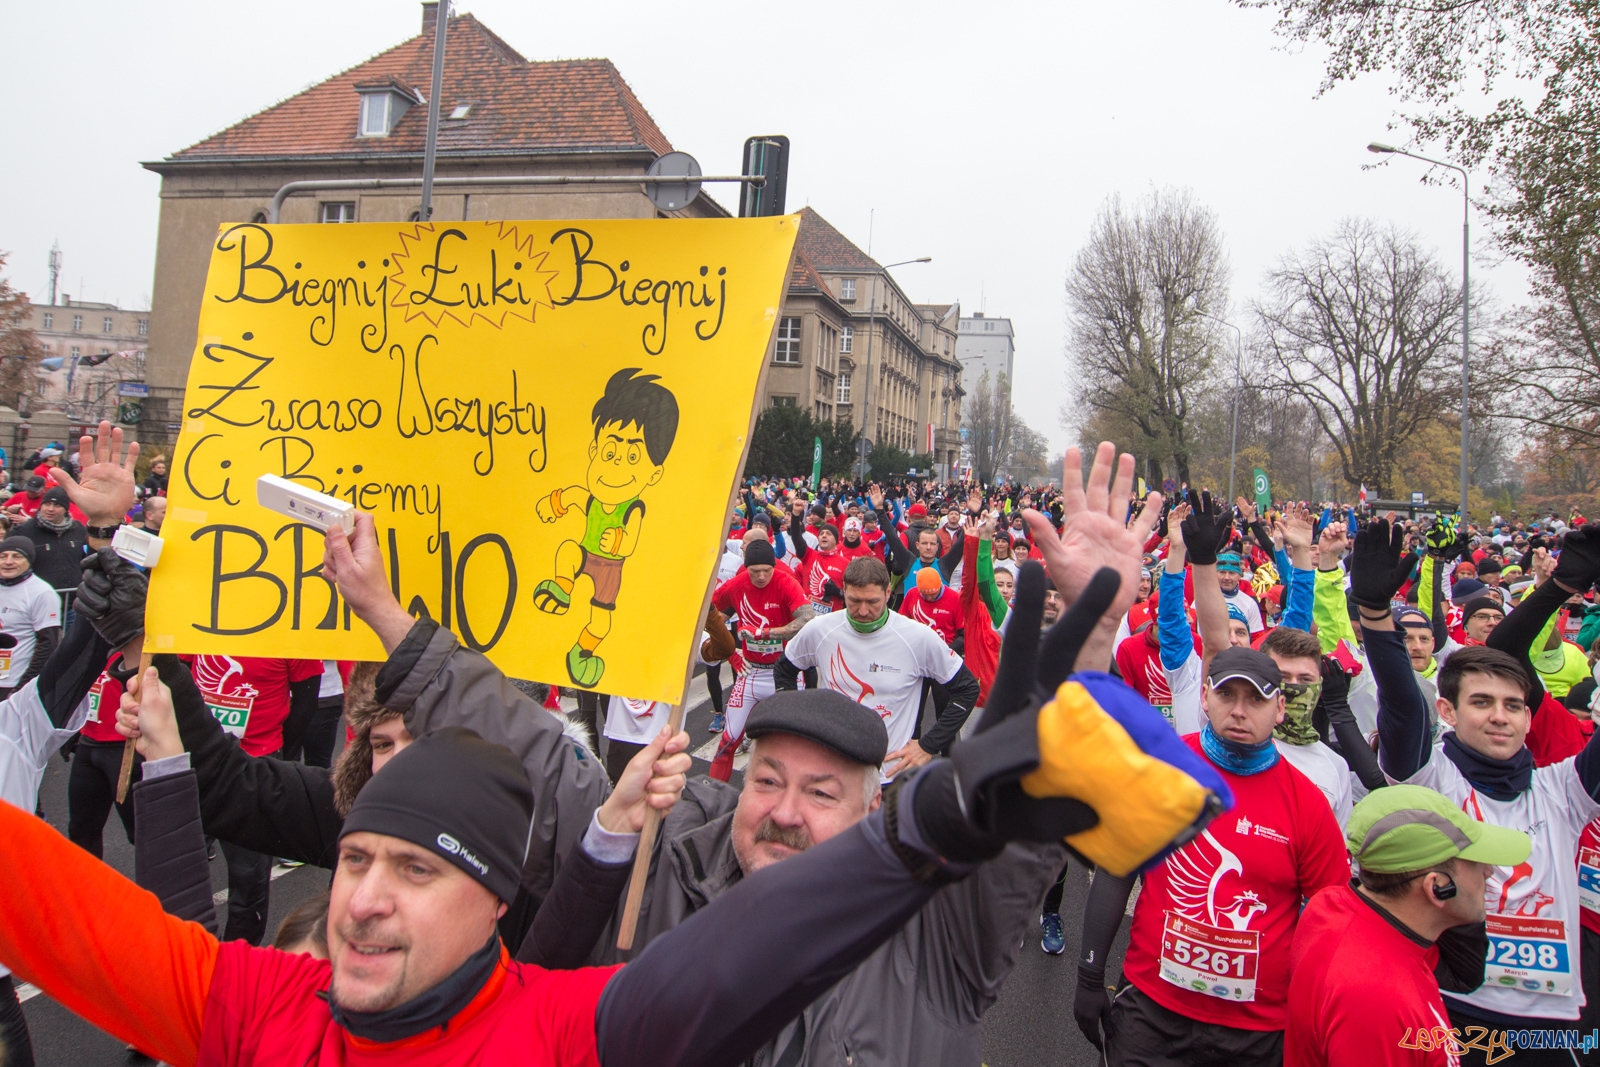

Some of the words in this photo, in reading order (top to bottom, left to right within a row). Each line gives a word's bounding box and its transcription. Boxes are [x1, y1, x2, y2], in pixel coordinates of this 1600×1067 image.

[215, 223, 390, 353] Biegnij
[410, 228, 533, 310] Łuki
[549, 228, 728, 355] Biegnij
[187, 332, 382, 433] Żwawo
[390, 334, 547, 475] Wszysty
[184, 434, 240, 506] Ci
[259, 436, 442, 553] Bijemy
[190, 523, 517, 653] BRWO
[1173, 939, 1245, 977] 5261
[1214, 935, 1252, 946] RunPoland.org
[1518, 925, 1559, 936] RunPoland.org
[1504, 968, 1528, 976] Marcin
